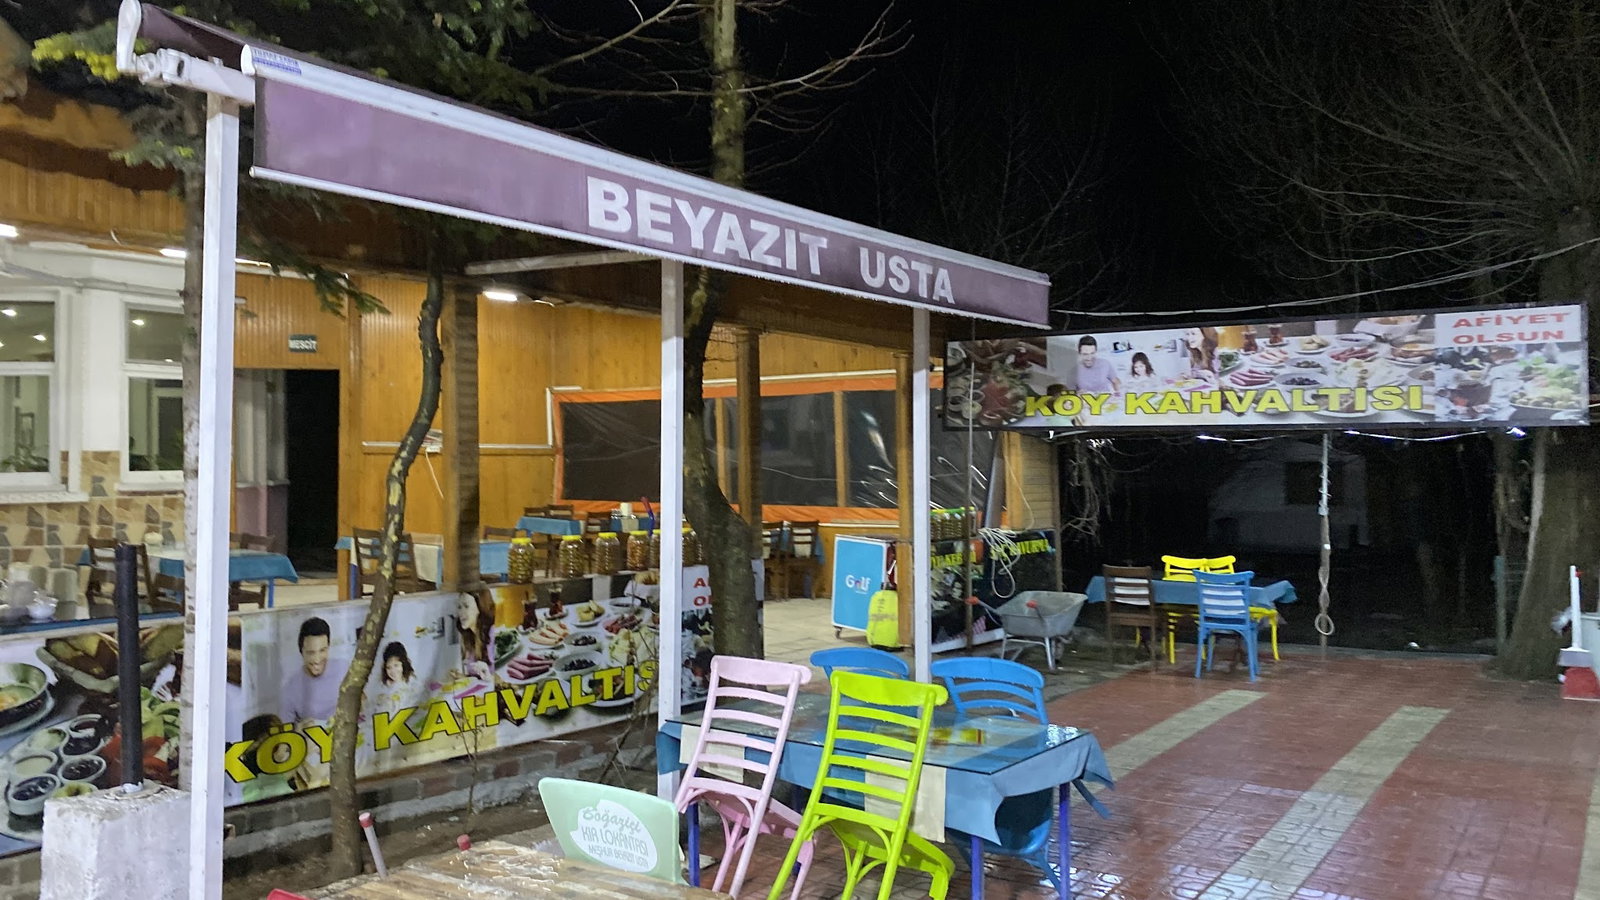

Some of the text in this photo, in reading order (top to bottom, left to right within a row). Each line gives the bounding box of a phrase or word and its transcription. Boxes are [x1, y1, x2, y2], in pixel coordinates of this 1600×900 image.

[587, 175, 955, 304] BEYAZIT USTA
[1452, 312, 1572, 328] AFİYET
[1452, 330, 1564, 344] OLSUN
[1025, 385, 1424, 416] KÖY KAHVALTISI
[372, 660, 659, 752] KAHVALTIS
